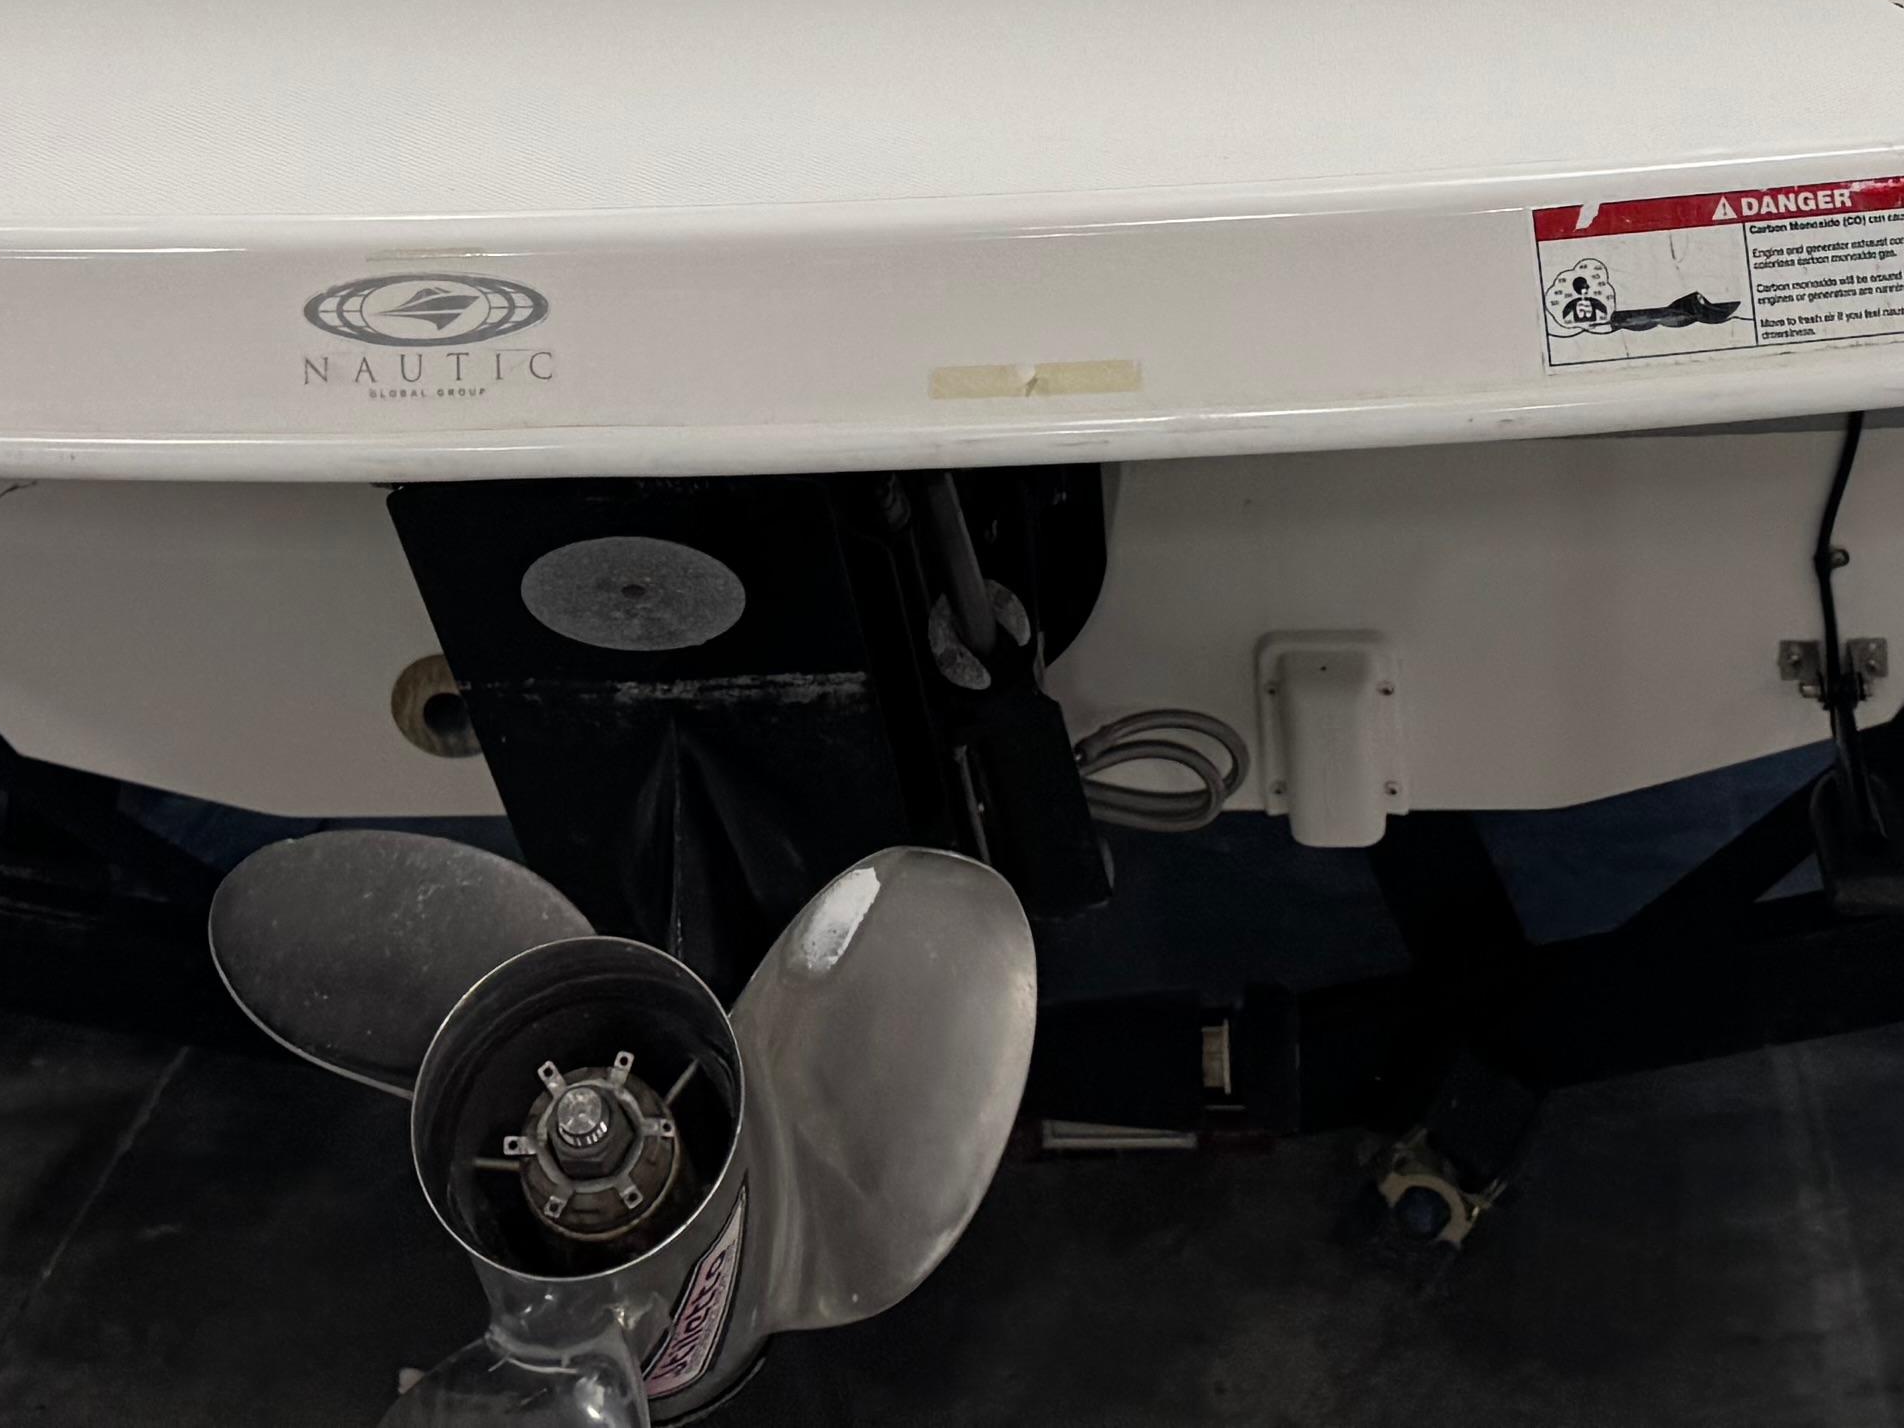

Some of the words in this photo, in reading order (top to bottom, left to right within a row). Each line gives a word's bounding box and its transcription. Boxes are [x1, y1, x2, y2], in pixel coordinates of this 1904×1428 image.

[1740, 191, 1853, 216] DANGER
[1750, 224, 1787, 233] Carbon
[1843, 216, 1865, 226] (CO)
[1753, 248, 1784, 259] Engine
[1806, 242, 1849, 255] generator
[1757, 283, 1790, 292] Carbon
[1788, 317, 1796, 326] to
[304, 352, 553, 385] NAUTIC
[369, 388, 426, 399] GLOBAL
[437, 388, 487, 398] GROUP
